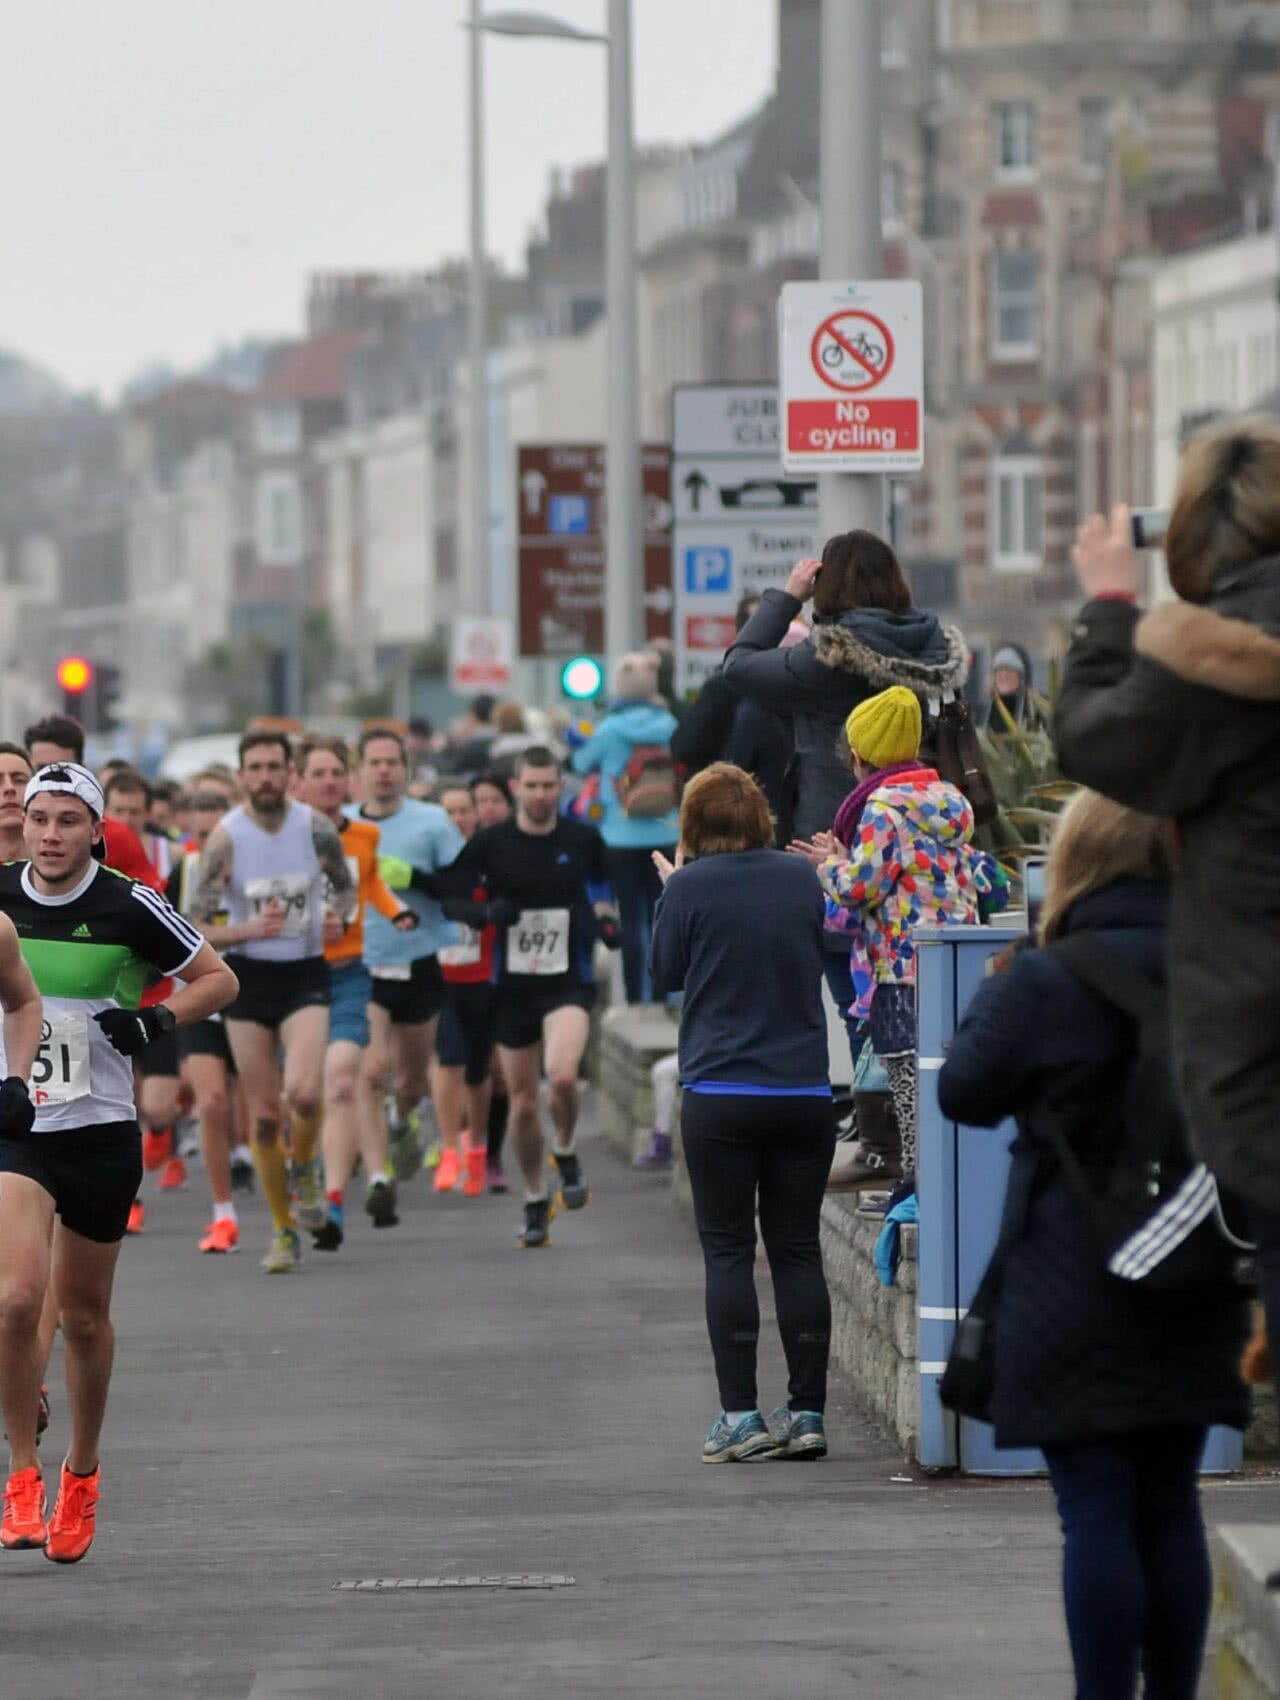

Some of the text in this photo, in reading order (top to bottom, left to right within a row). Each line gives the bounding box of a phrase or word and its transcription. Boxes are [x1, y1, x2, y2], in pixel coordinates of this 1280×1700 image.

[836, 401, 870, 422] No
[809, 424, 897, 450] cycling
[749, 532, 813, 552] Town
[518, 930, 560, 955] 697
